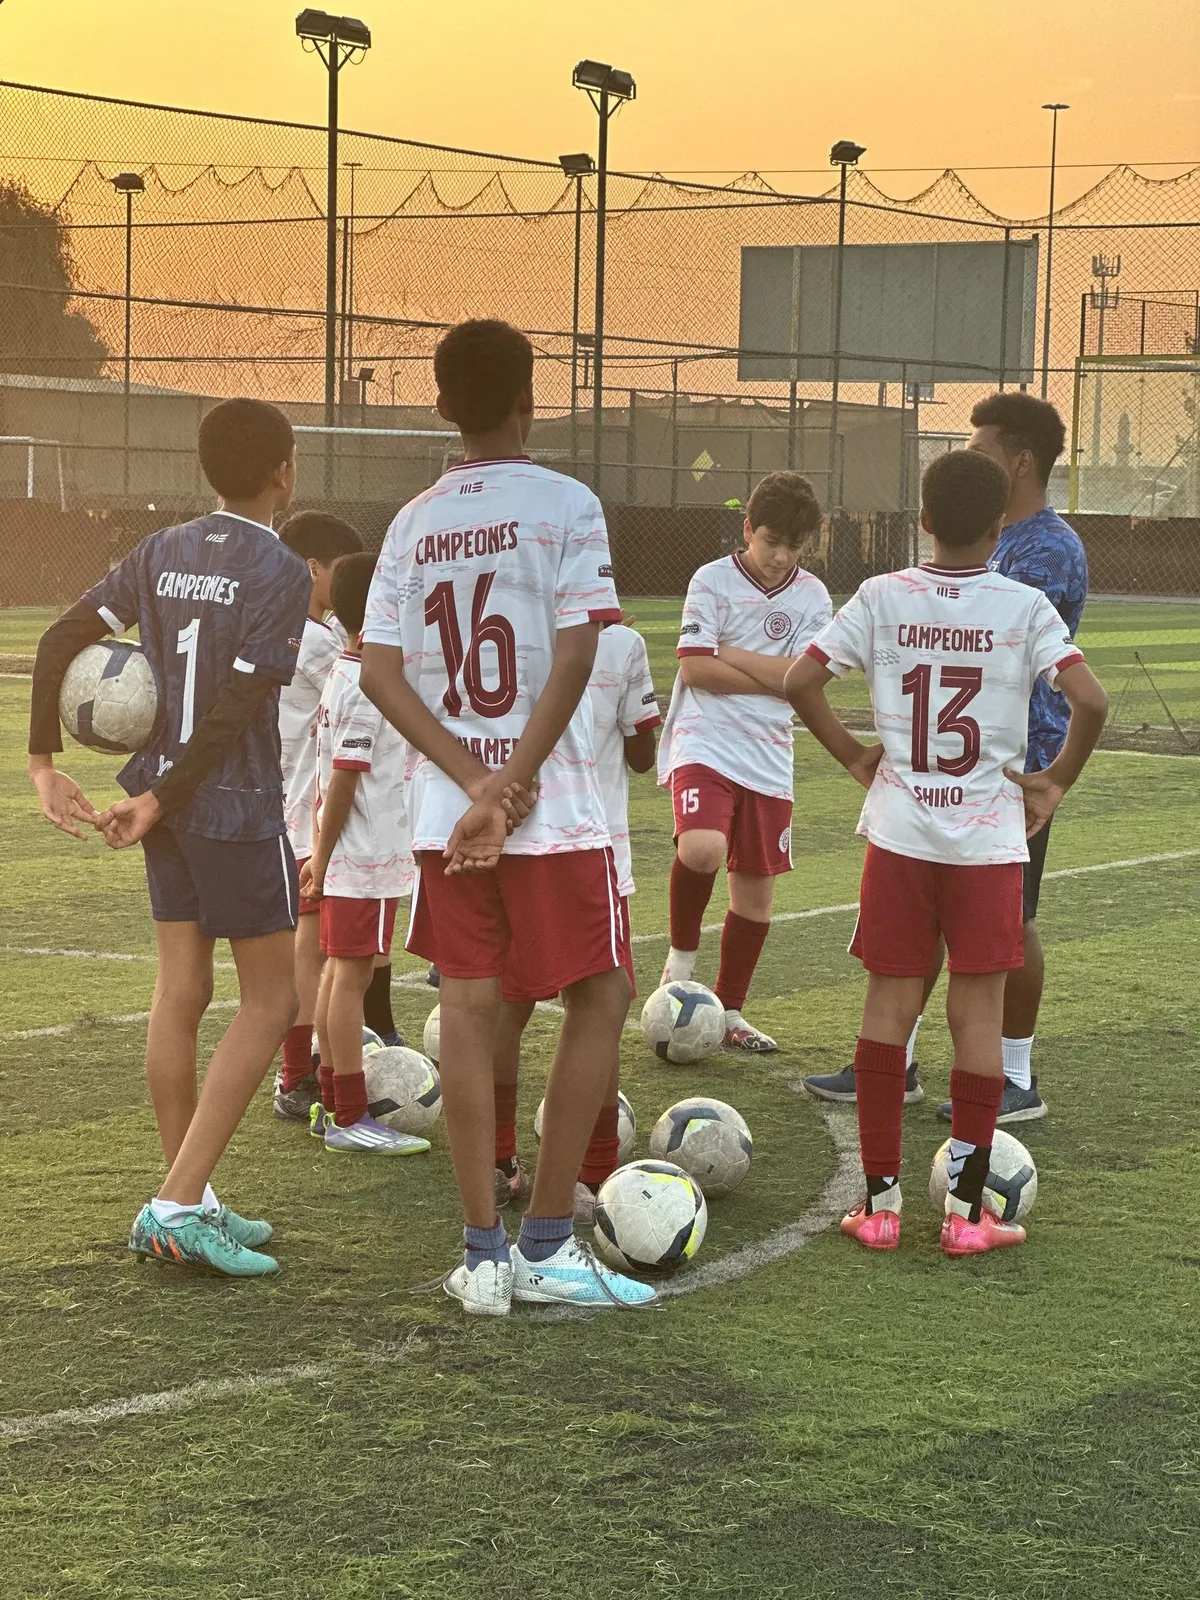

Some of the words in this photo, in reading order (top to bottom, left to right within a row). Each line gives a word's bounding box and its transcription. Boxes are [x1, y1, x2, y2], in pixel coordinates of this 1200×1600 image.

[415, 520, 519, 565] CAMPEONES
[156, 571, 239, 605] CAMPEONES
[424, 569, 518, 719] 16
[898, 624, 994, 652] CAMPEONES
[176, 618, 200, 744] 1
[902, 663, 983, 778] 13
[680, 787, 700, 815] 15
[913, 785, 963, 808] SHIKO
